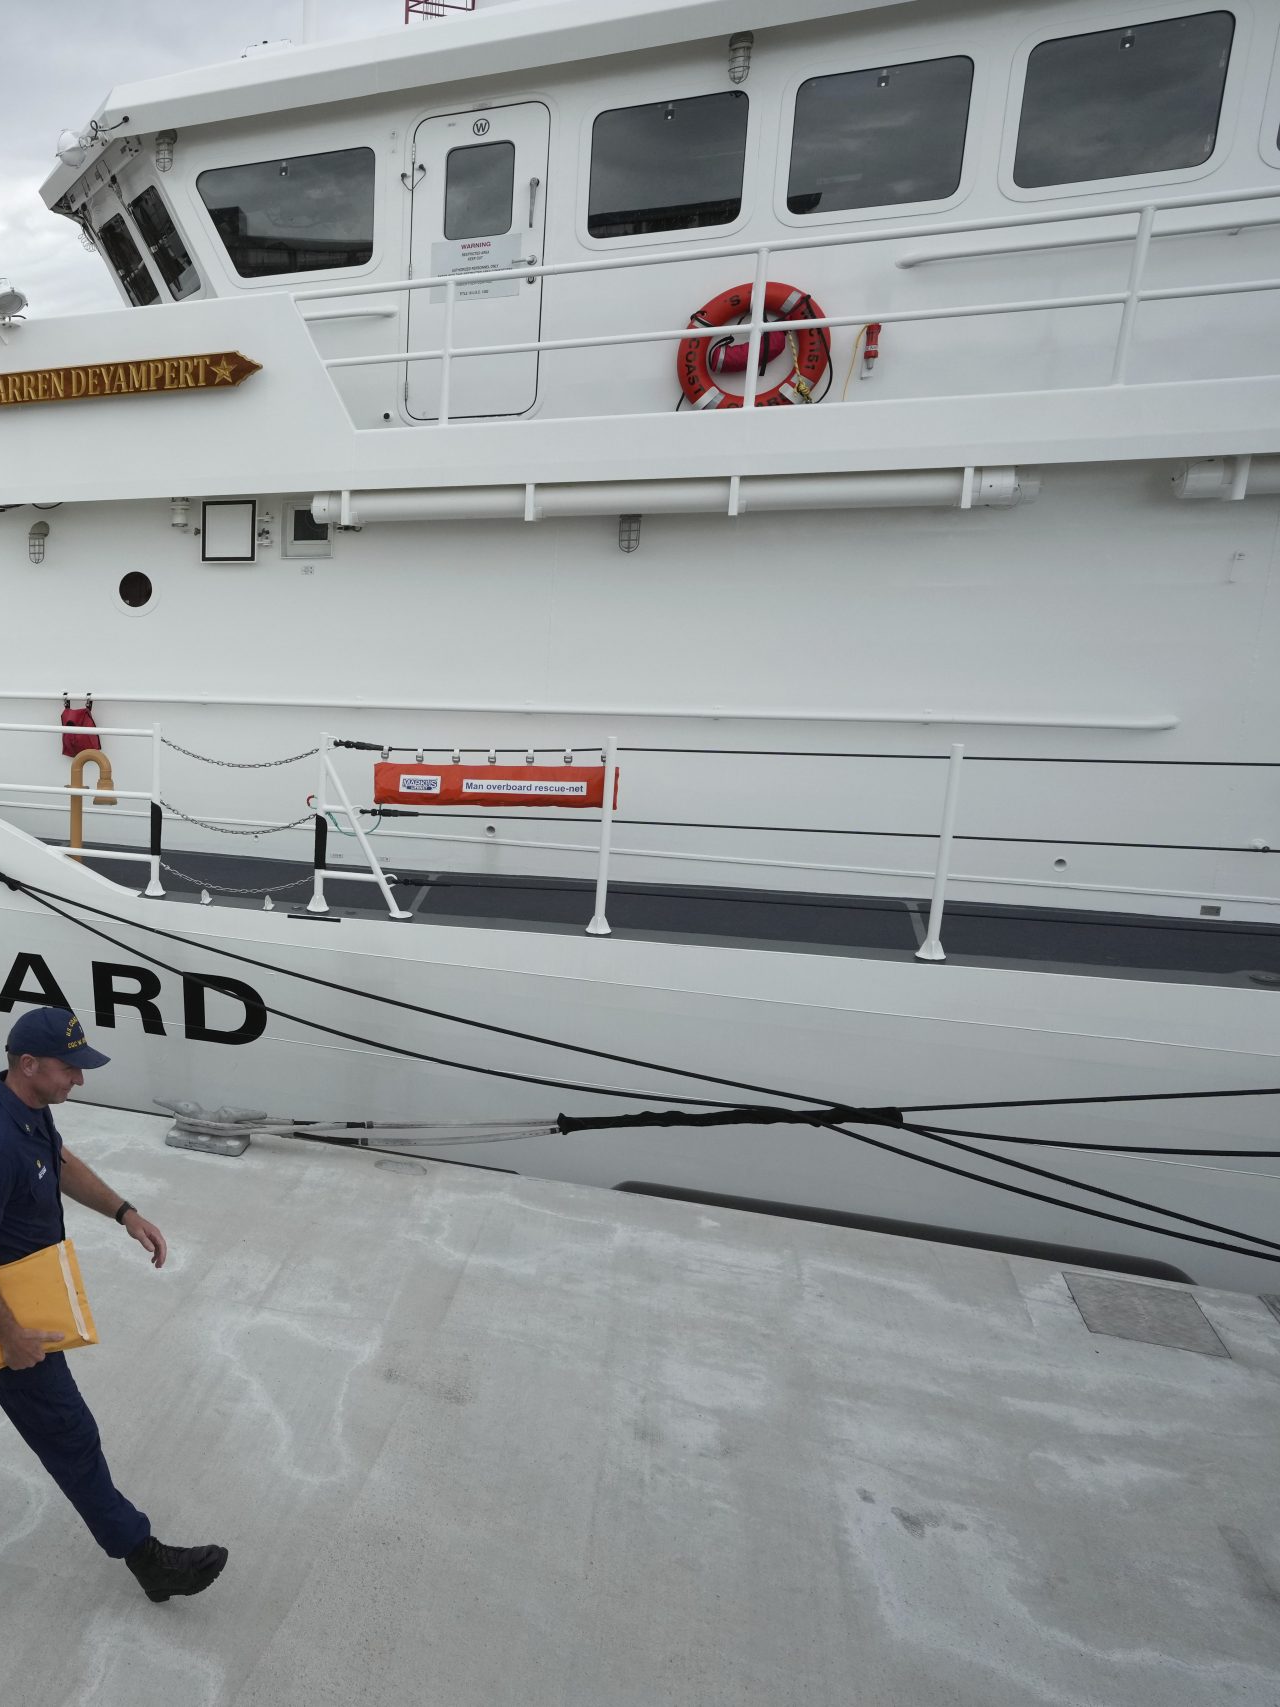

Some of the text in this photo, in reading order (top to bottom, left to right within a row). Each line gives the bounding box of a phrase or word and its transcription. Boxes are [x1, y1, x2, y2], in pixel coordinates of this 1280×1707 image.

[461, 241, 491, 250] WARNING
[684, 336, 706, 396] COAST
[70, 356, 212, 398] DEYAMPERT
[402, 778, 438, 788] MARKUS
[465, 781, 584, 793] Man overboard rescue-net
